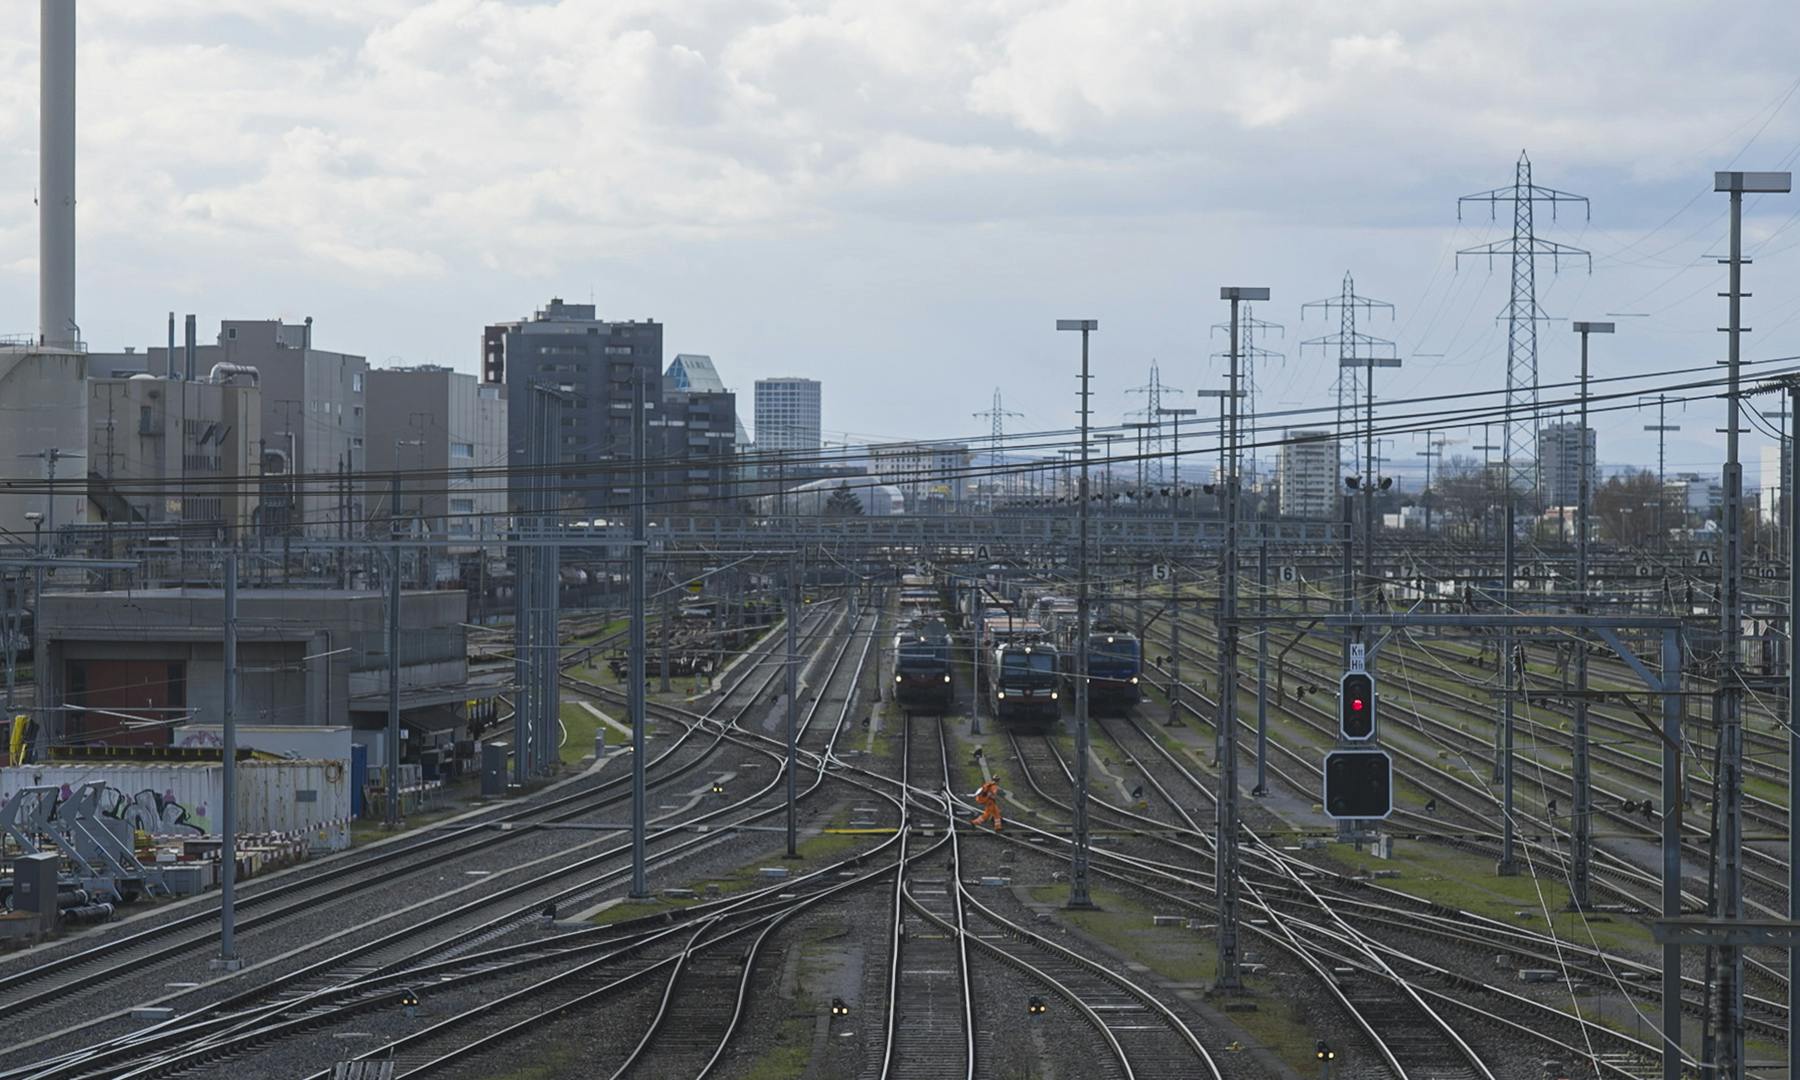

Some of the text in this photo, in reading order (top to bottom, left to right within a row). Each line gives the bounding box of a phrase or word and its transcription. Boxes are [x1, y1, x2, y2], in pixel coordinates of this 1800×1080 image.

[978, 546, 989, 561] A
[1698, 550, 1710, 564] A
[1156, 566, 1166, 580] 5
[1284, 567, 1293, 581] 6
